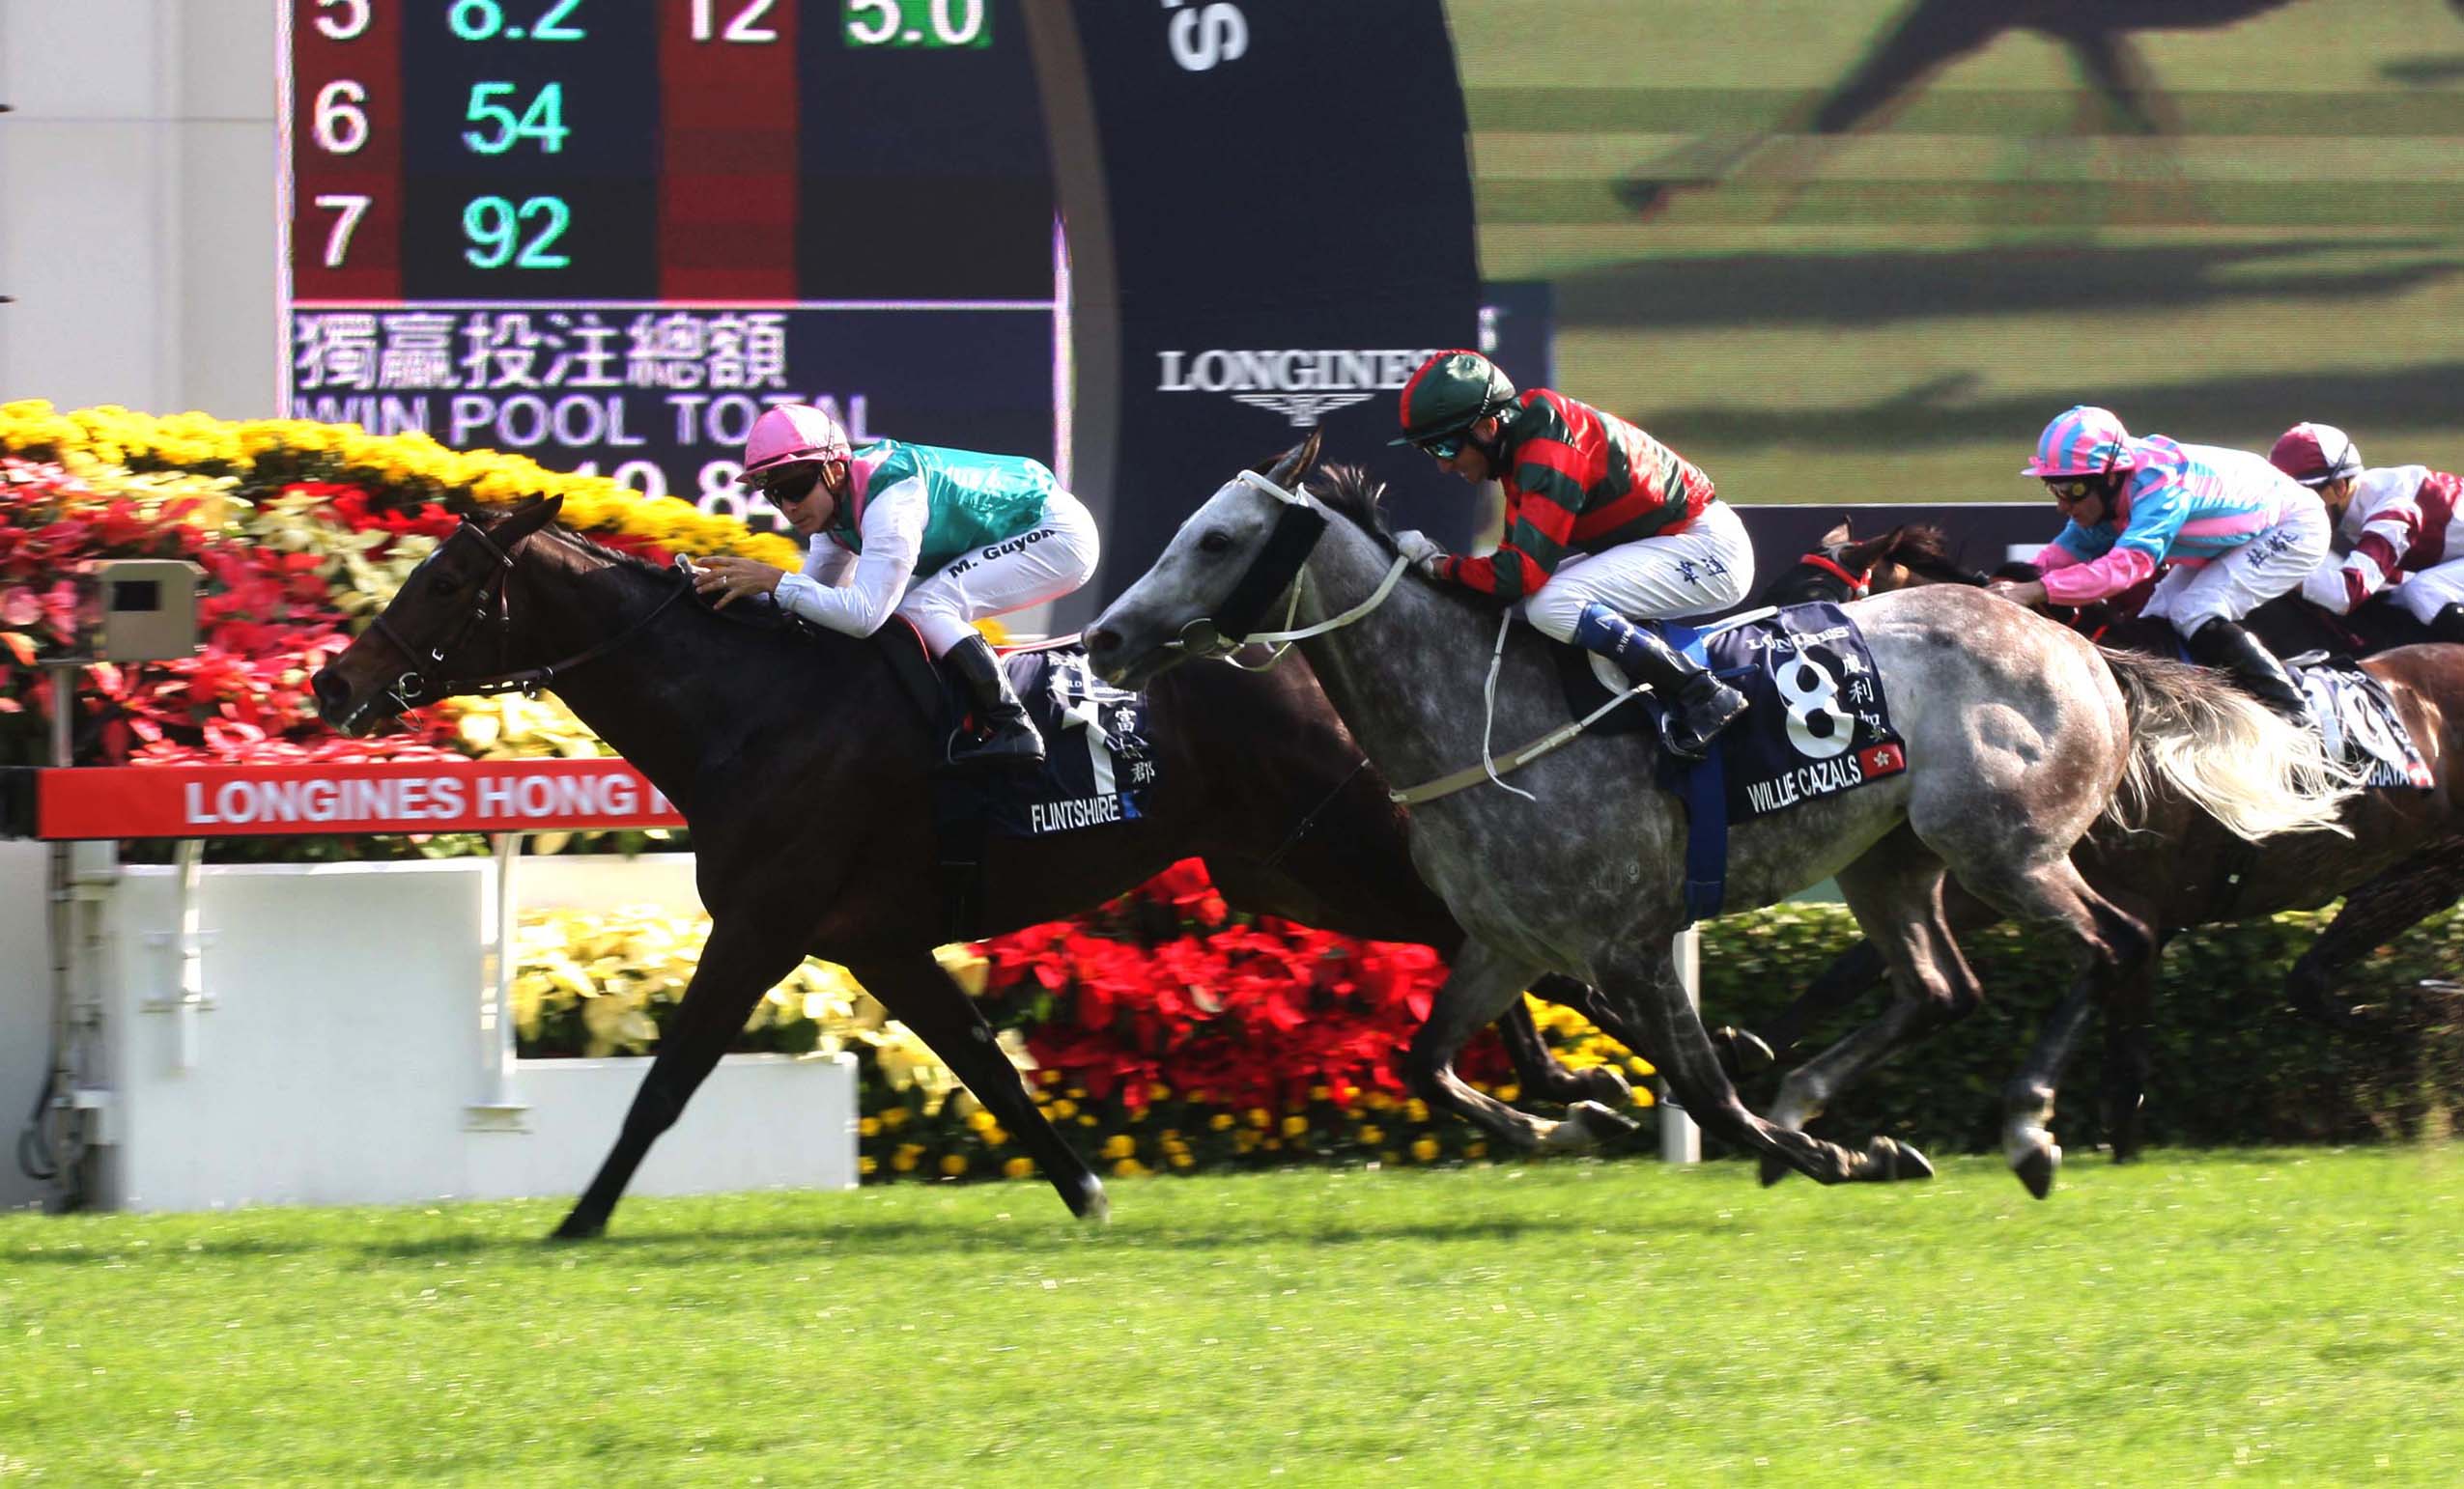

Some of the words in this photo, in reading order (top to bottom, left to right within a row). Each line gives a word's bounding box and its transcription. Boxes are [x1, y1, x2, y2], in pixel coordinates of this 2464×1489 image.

[1162, 0, 1249, 70] S
[313, 80, 368, 153] 6
[464, 83, 569, 153] 54
[314, 196, 371, 267] 7
[464, 197, 570, 267] 92
[295, 312, 787, 389] 獨贏投注總額
[450, 393, 646, 446] POOL
[665, 393, 884, 446] TOL
[948, 559, 977, 578] M.
[982, 528, 1056, 560] Guyon
[1776, 649, 1855, 758] 8
[185, 776, 467, 824] LONGINES
[477, 773, 637, 817] HONG
[1031, 794, 1120, 833] FLINTSHIRE
[1746, 772, 1800, 813] WILLIE
[1798, 754, 1862, 796] CAZALS
